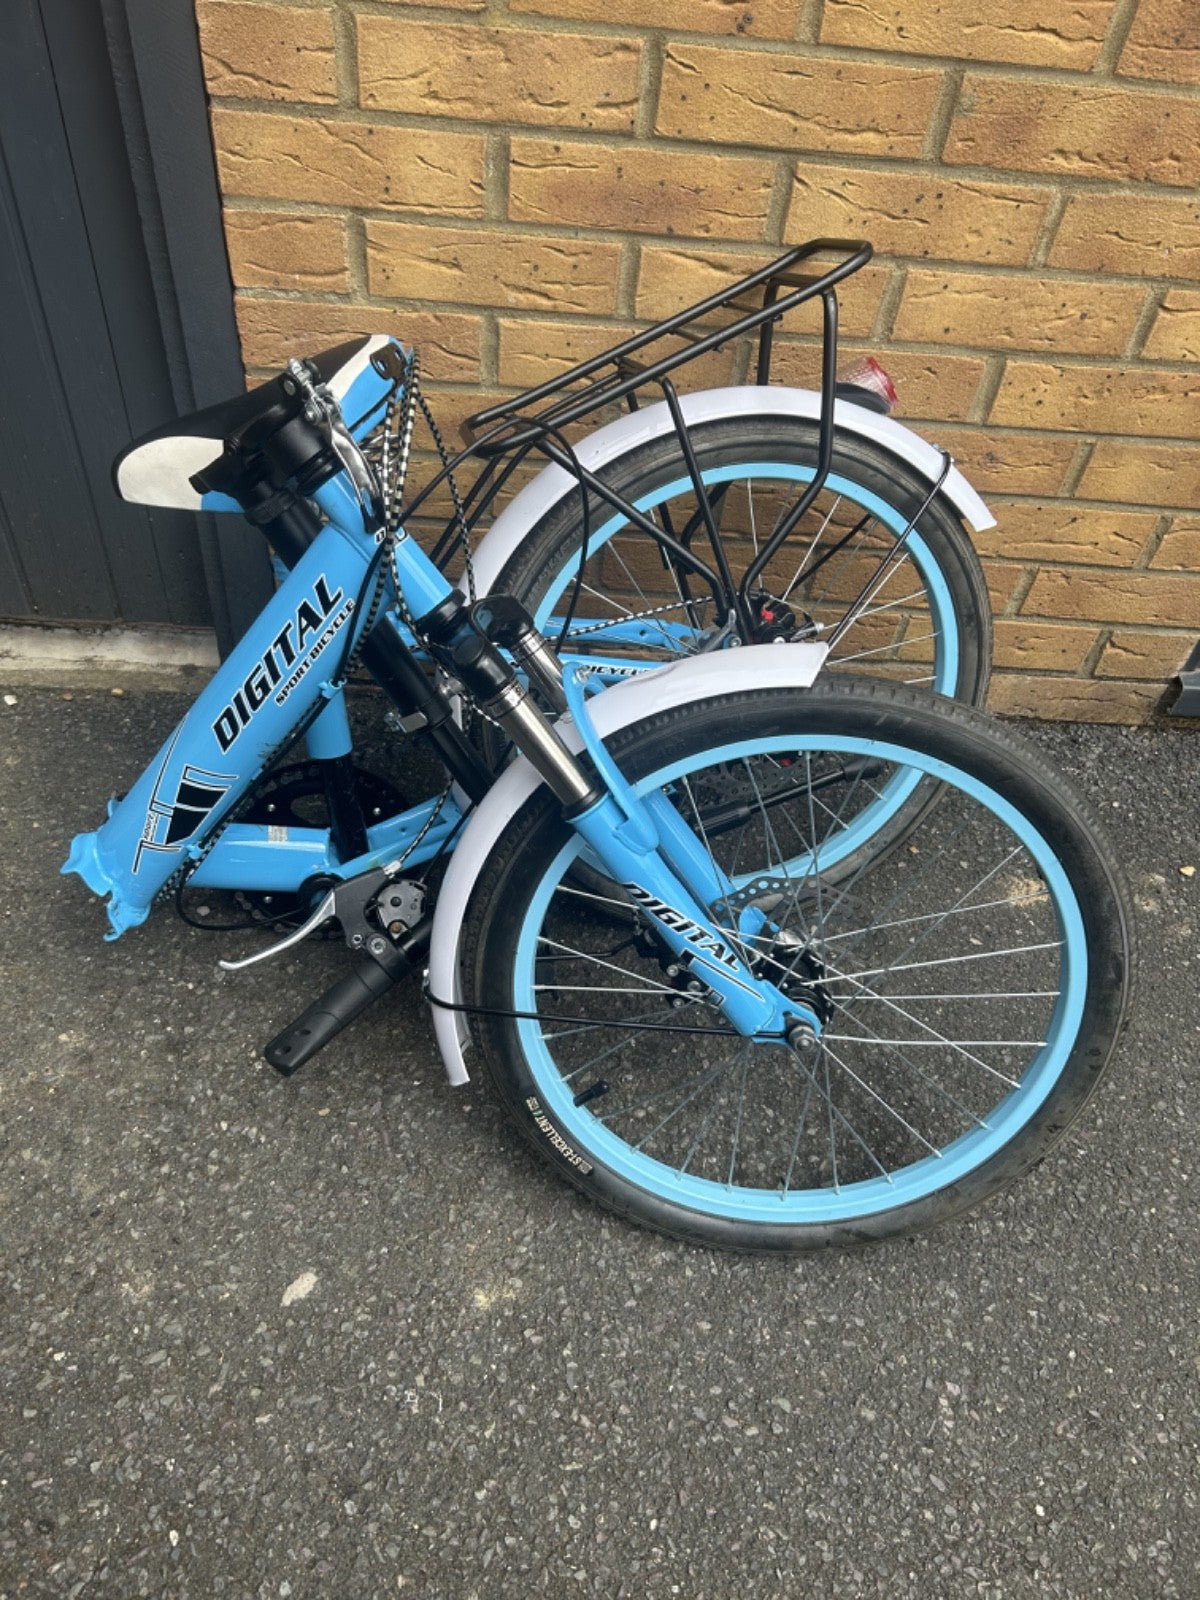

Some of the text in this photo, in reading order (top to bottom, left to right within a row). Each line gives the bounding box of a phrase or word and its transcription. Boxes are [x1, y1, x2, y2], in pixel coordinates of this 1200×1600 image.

[212, 574, 342, 754] DIGITAL
[275, 599, 355, 705] SPORT BICYCLE
[622, 882, 749, 972] DIGITAL
